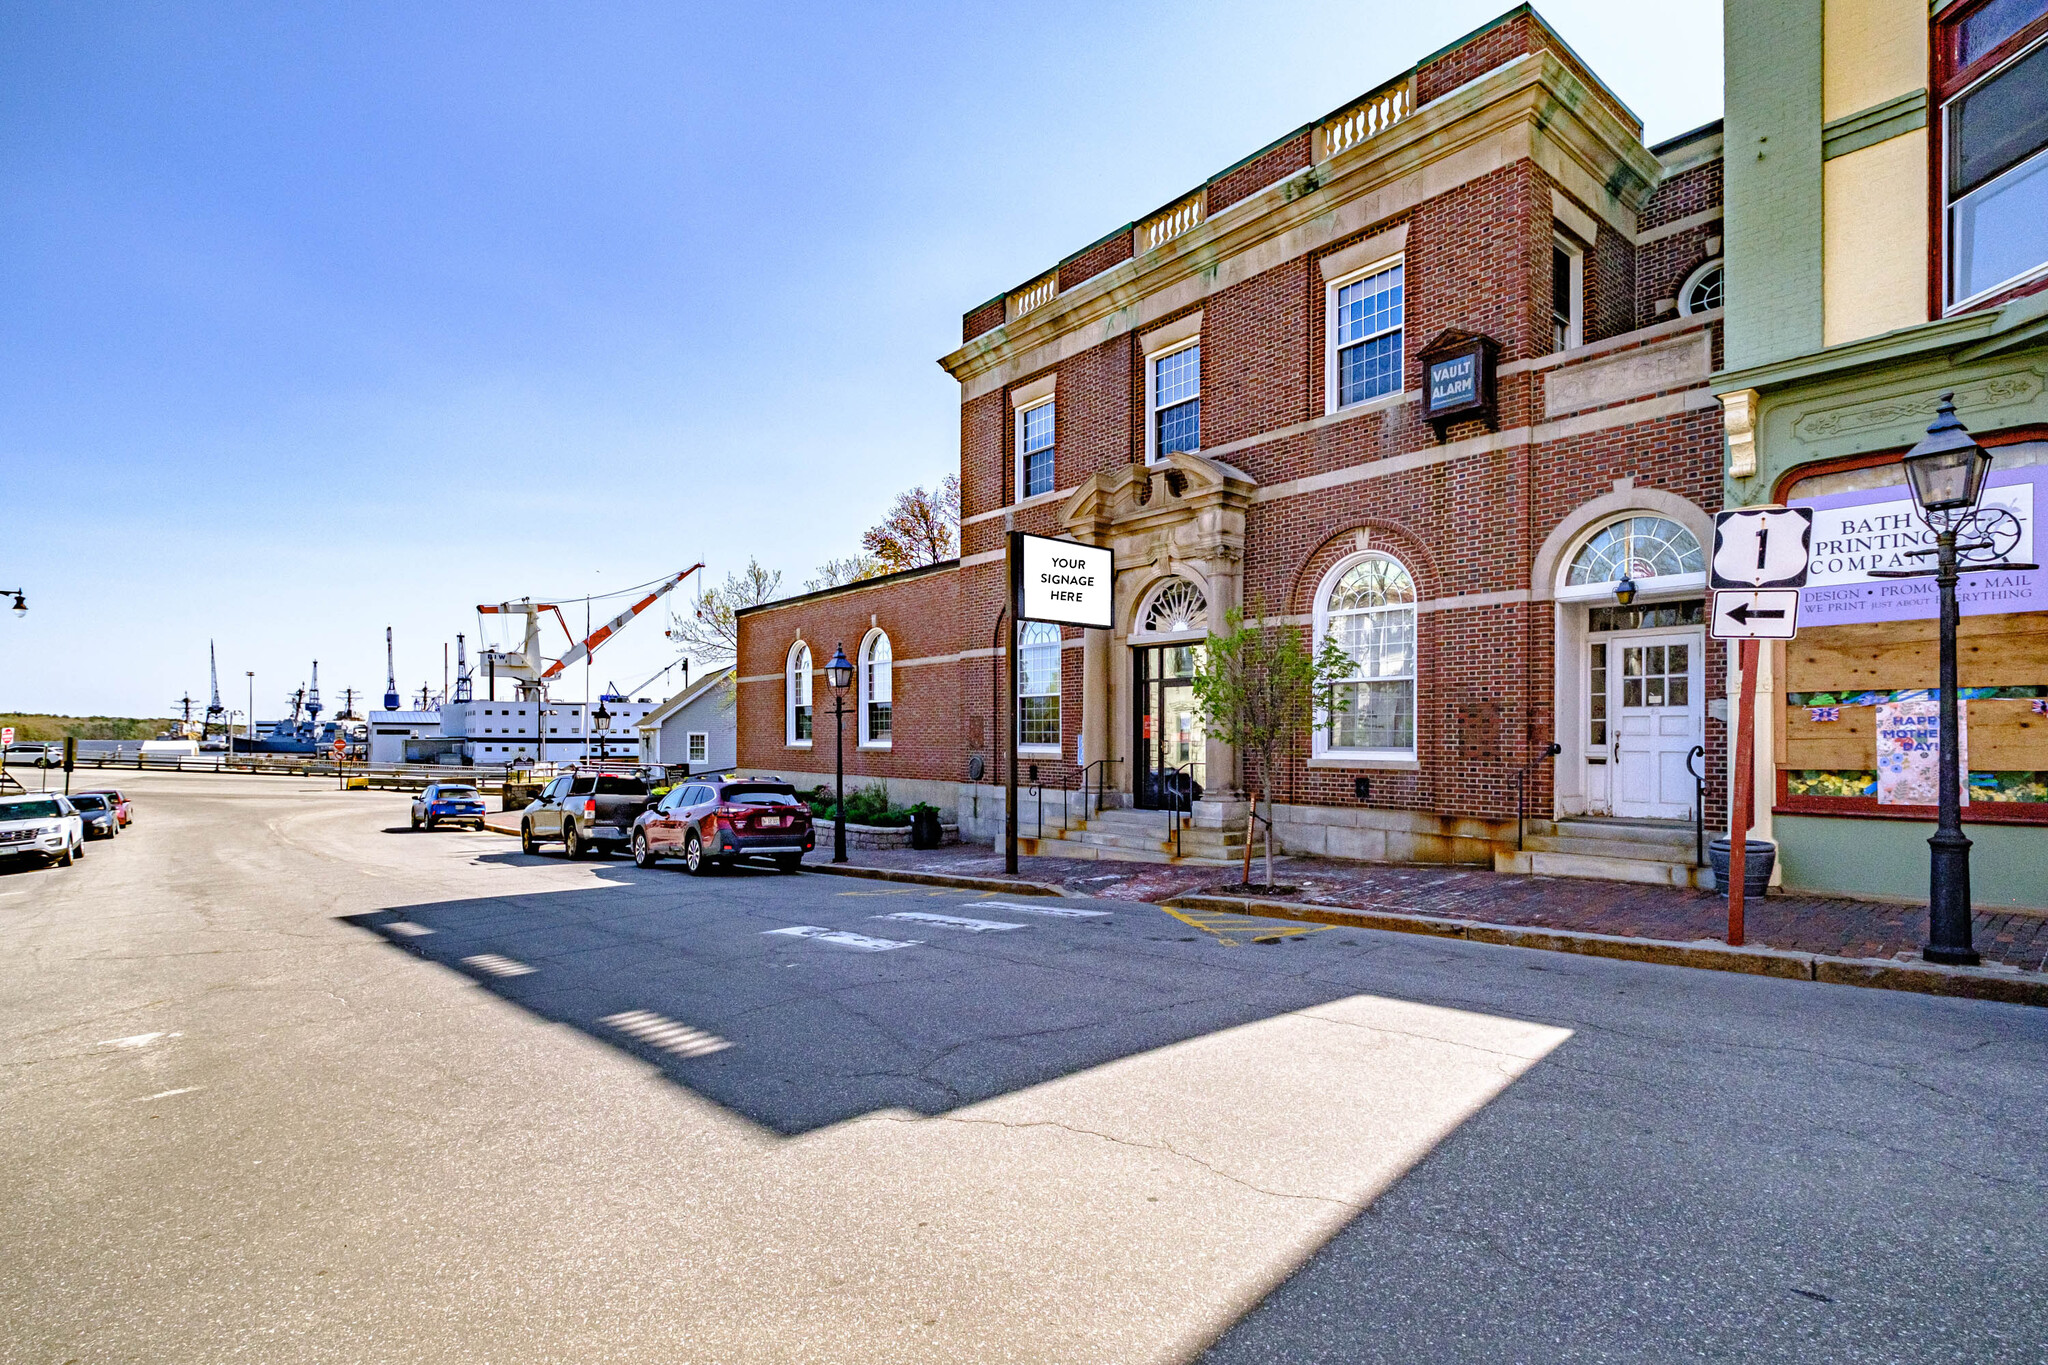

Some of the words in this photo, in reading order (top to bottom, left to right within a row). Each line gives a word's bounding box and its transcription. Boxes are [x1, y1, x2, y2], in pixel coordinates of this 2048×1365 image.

[1433, 361, 1470, 382] VAULT
[1432, 377, 1472, 400] ALARM
[1841, 512, 1912, 536] BATH
[1755, 528, 1769, 570] 1
[1815, 529, 1939, 557] PRINTING
[1051, 558, 1086, 569] YOUR
[1809, 550, 1939, 575] COMPAN
[1041, 573, 1095, 586] SIGNAGE
[1051, 590, 1083, 602] HERE
[1804, 588, 1860, 603] DESIGN
[1985, 575, 2032, 589] MAIL
[1804, 604, 1824, 613] WE
[1828, 600, 1867, 612] PRINT
[1870, 601, 1893, 610] JUST
[1896, 598, 1930, 608] ABOUT
[1893, 716, 1939, 725] HAPP
[1882, 729, 1938, 739] MOTHE
[1903, 742, 1939, 751] DAY!
